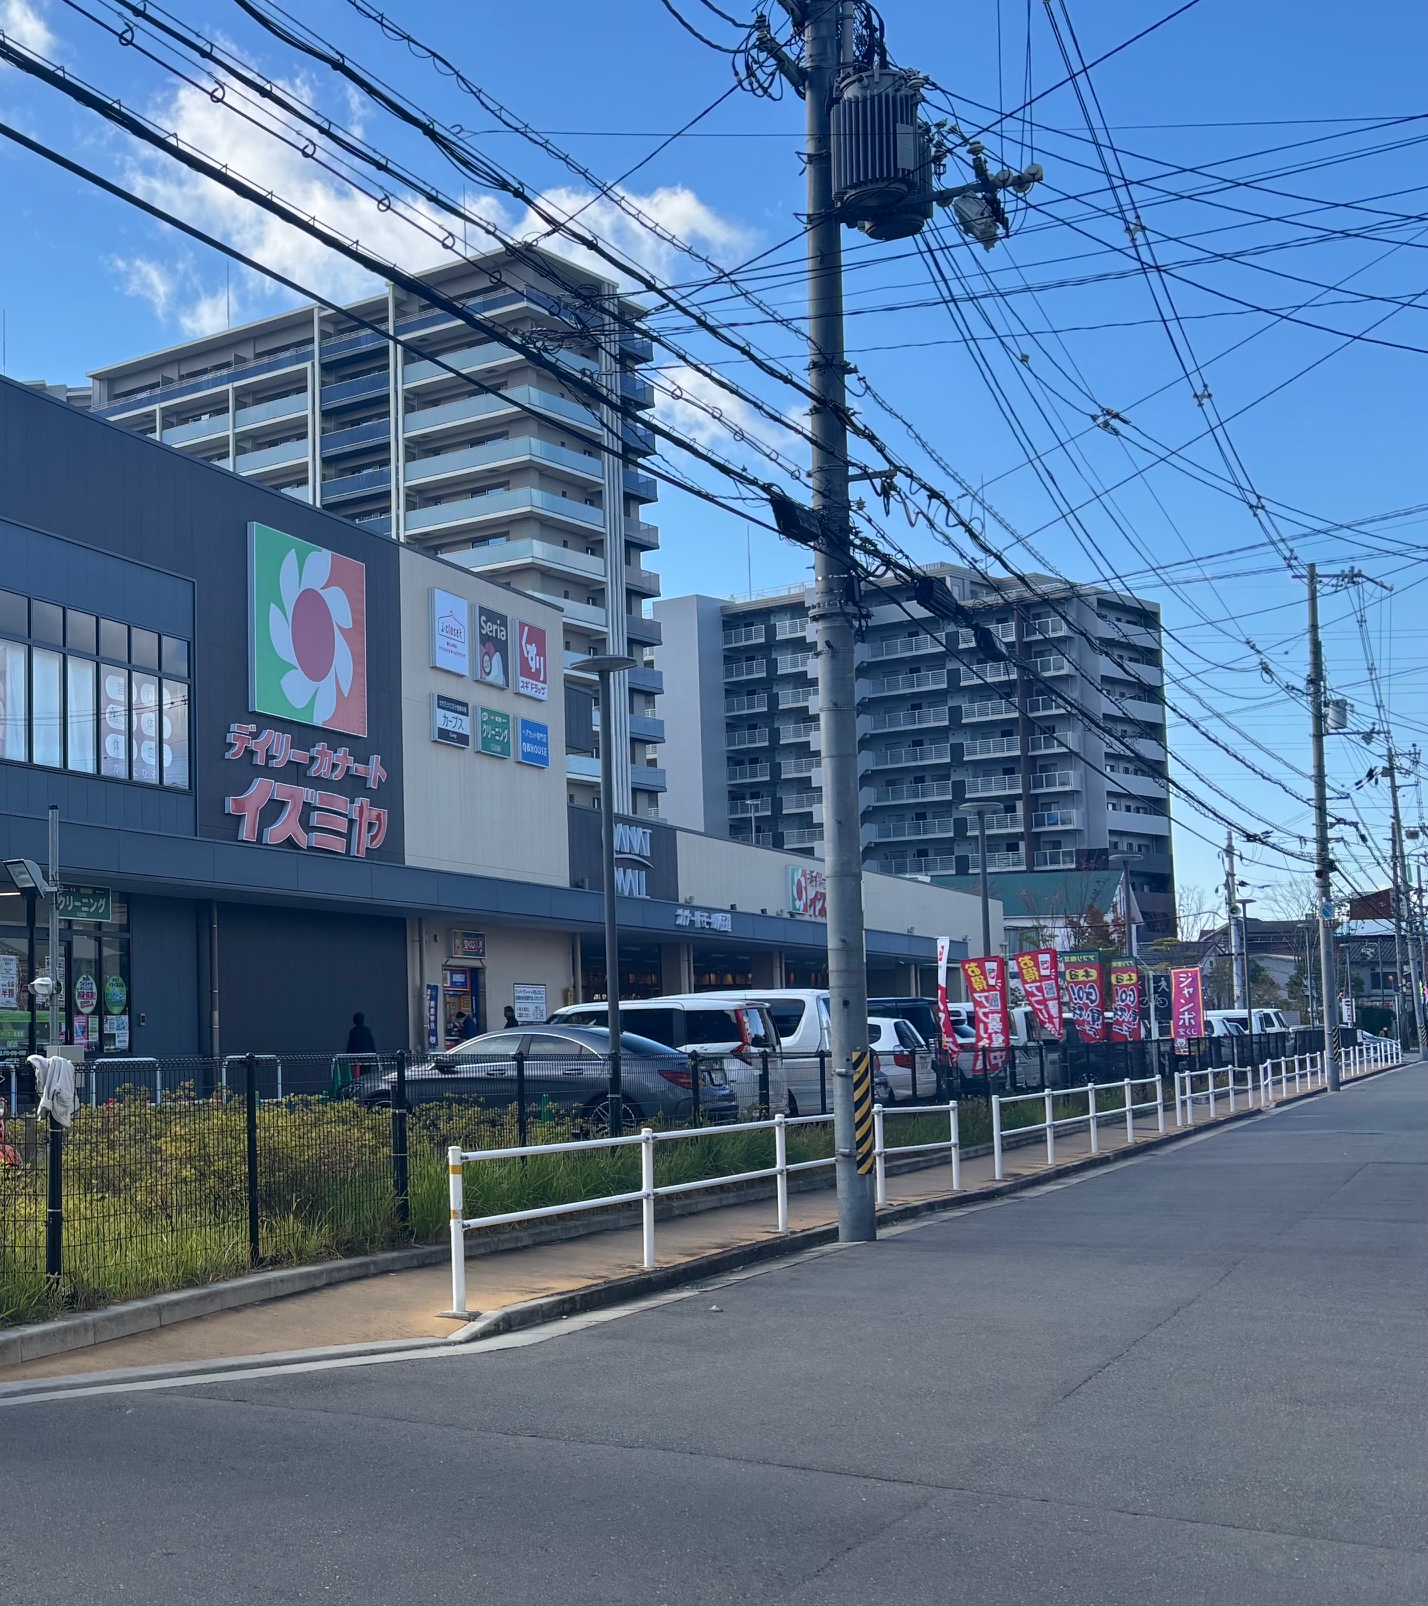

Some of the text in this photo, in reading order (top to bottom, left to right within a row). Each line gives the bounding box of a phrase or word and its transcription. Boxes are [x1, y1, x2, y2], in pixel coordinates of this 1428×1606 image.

[480, 615, 507, 642] Seria
[521, 626, 544, 681] くすり
[442, 713, 464, 731] カーブス
[482, 723, 509, 743] クリーニング
[224, 777, 388, 858] イズミヤ
[603, 822, 652, 857] ANAT
[1178, 972, 1197, 1027] ジャンボ
